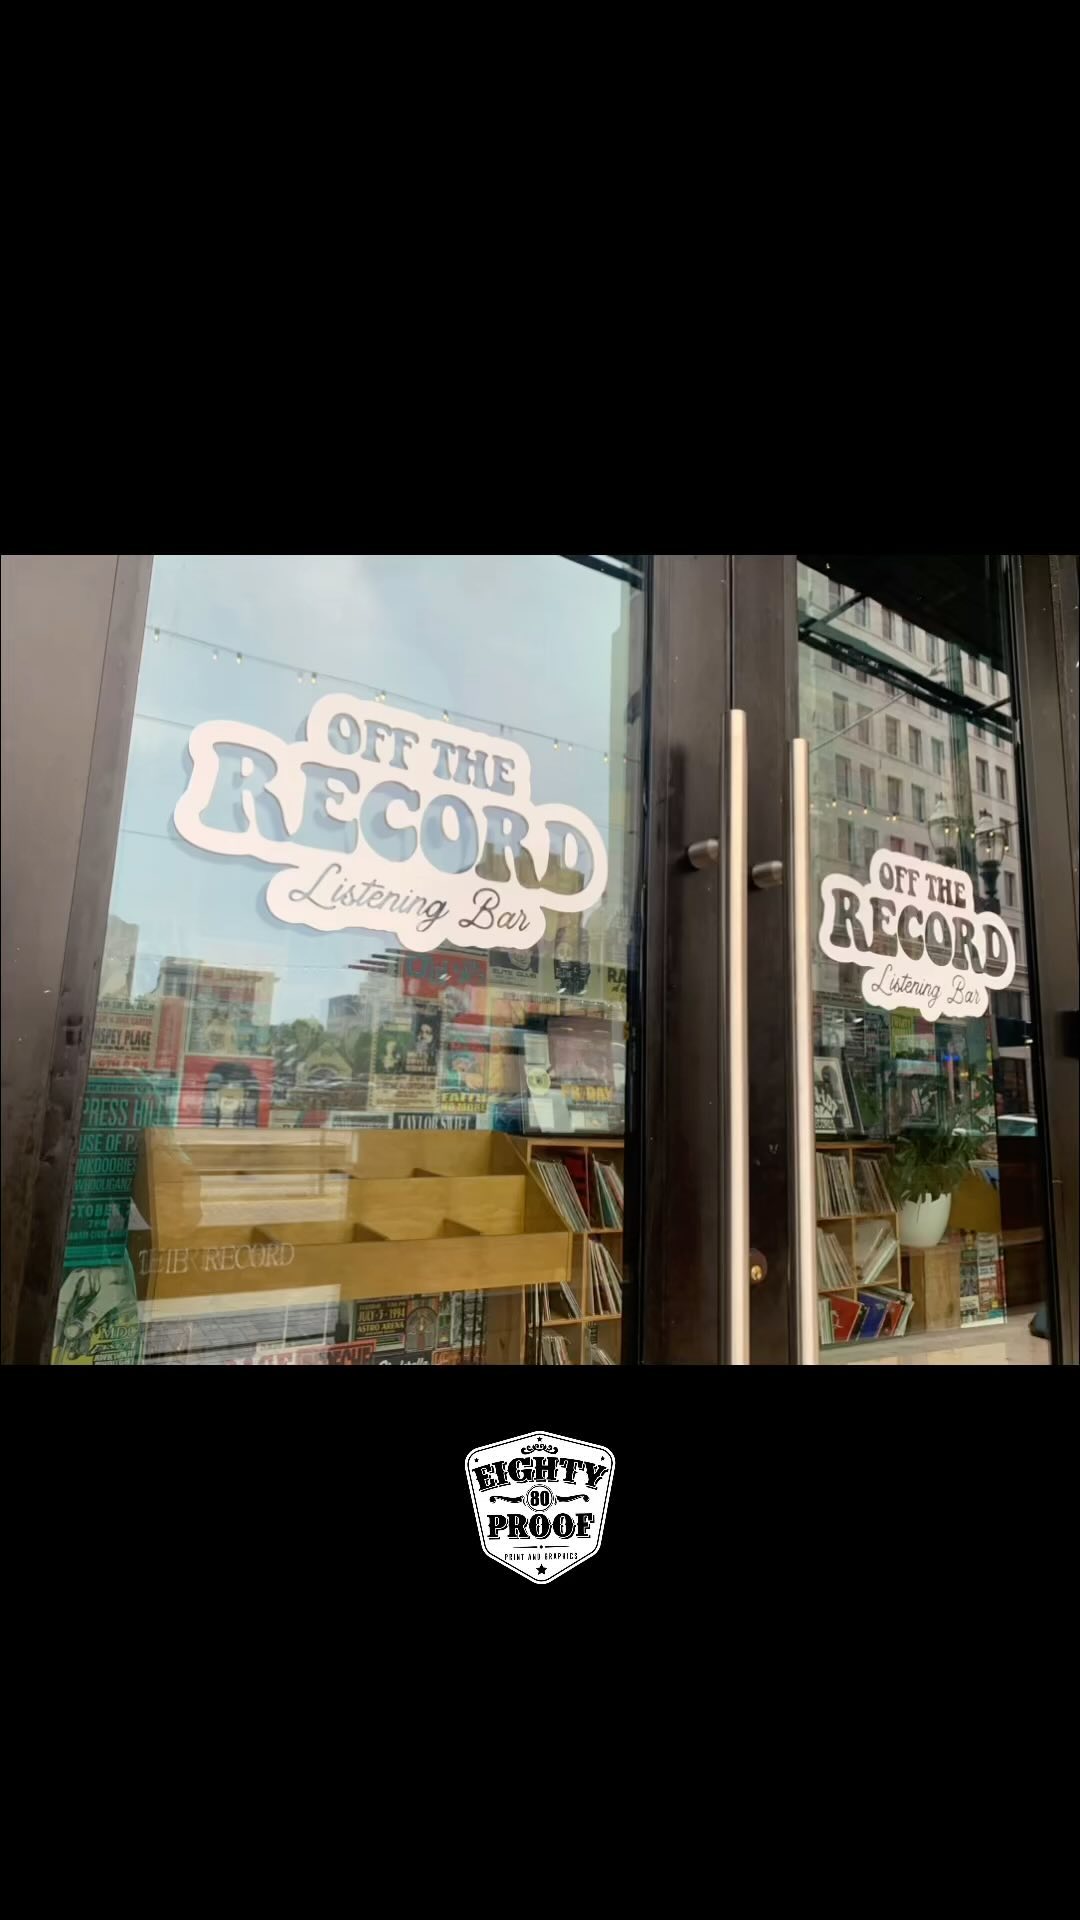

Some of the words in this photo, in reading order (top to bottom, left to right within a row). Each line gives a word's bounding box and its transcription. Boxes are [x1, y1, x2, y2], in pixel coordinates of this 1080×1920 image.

[328, 713, 419, 770] OFF
[431, 738, 516, 796] THE
[199, 741, 595, 896] RECORD
[879, 862, 920, 897] OFF
[925, 873, 966, 909] THE
[288, 863, 449, 933] Listening
[459, 888, 530, 932] Bar
[830, 888, 1008, 978] RECORD
[871, 963, 941, 1008] Listening
[947, 974, 982, 1005] Bar
[125, 1030, 152, 1046] PLACE
[442, 1093, 488, 1102] FAITH
[458, 1103, 487, 1113] MORE
[398, 1115, 437, 1130] TAYLOR
[441, 1115, 471, 1130] SWIFT
[105, 1134, 122, 1152] OF
[201, 1242, 295, 1273] RECORD
[357, 1323, 380, 1334] ASTRO
[382, 1321, 405, 1332] ARENA
[360, 1310, 375, 1322] JULY
